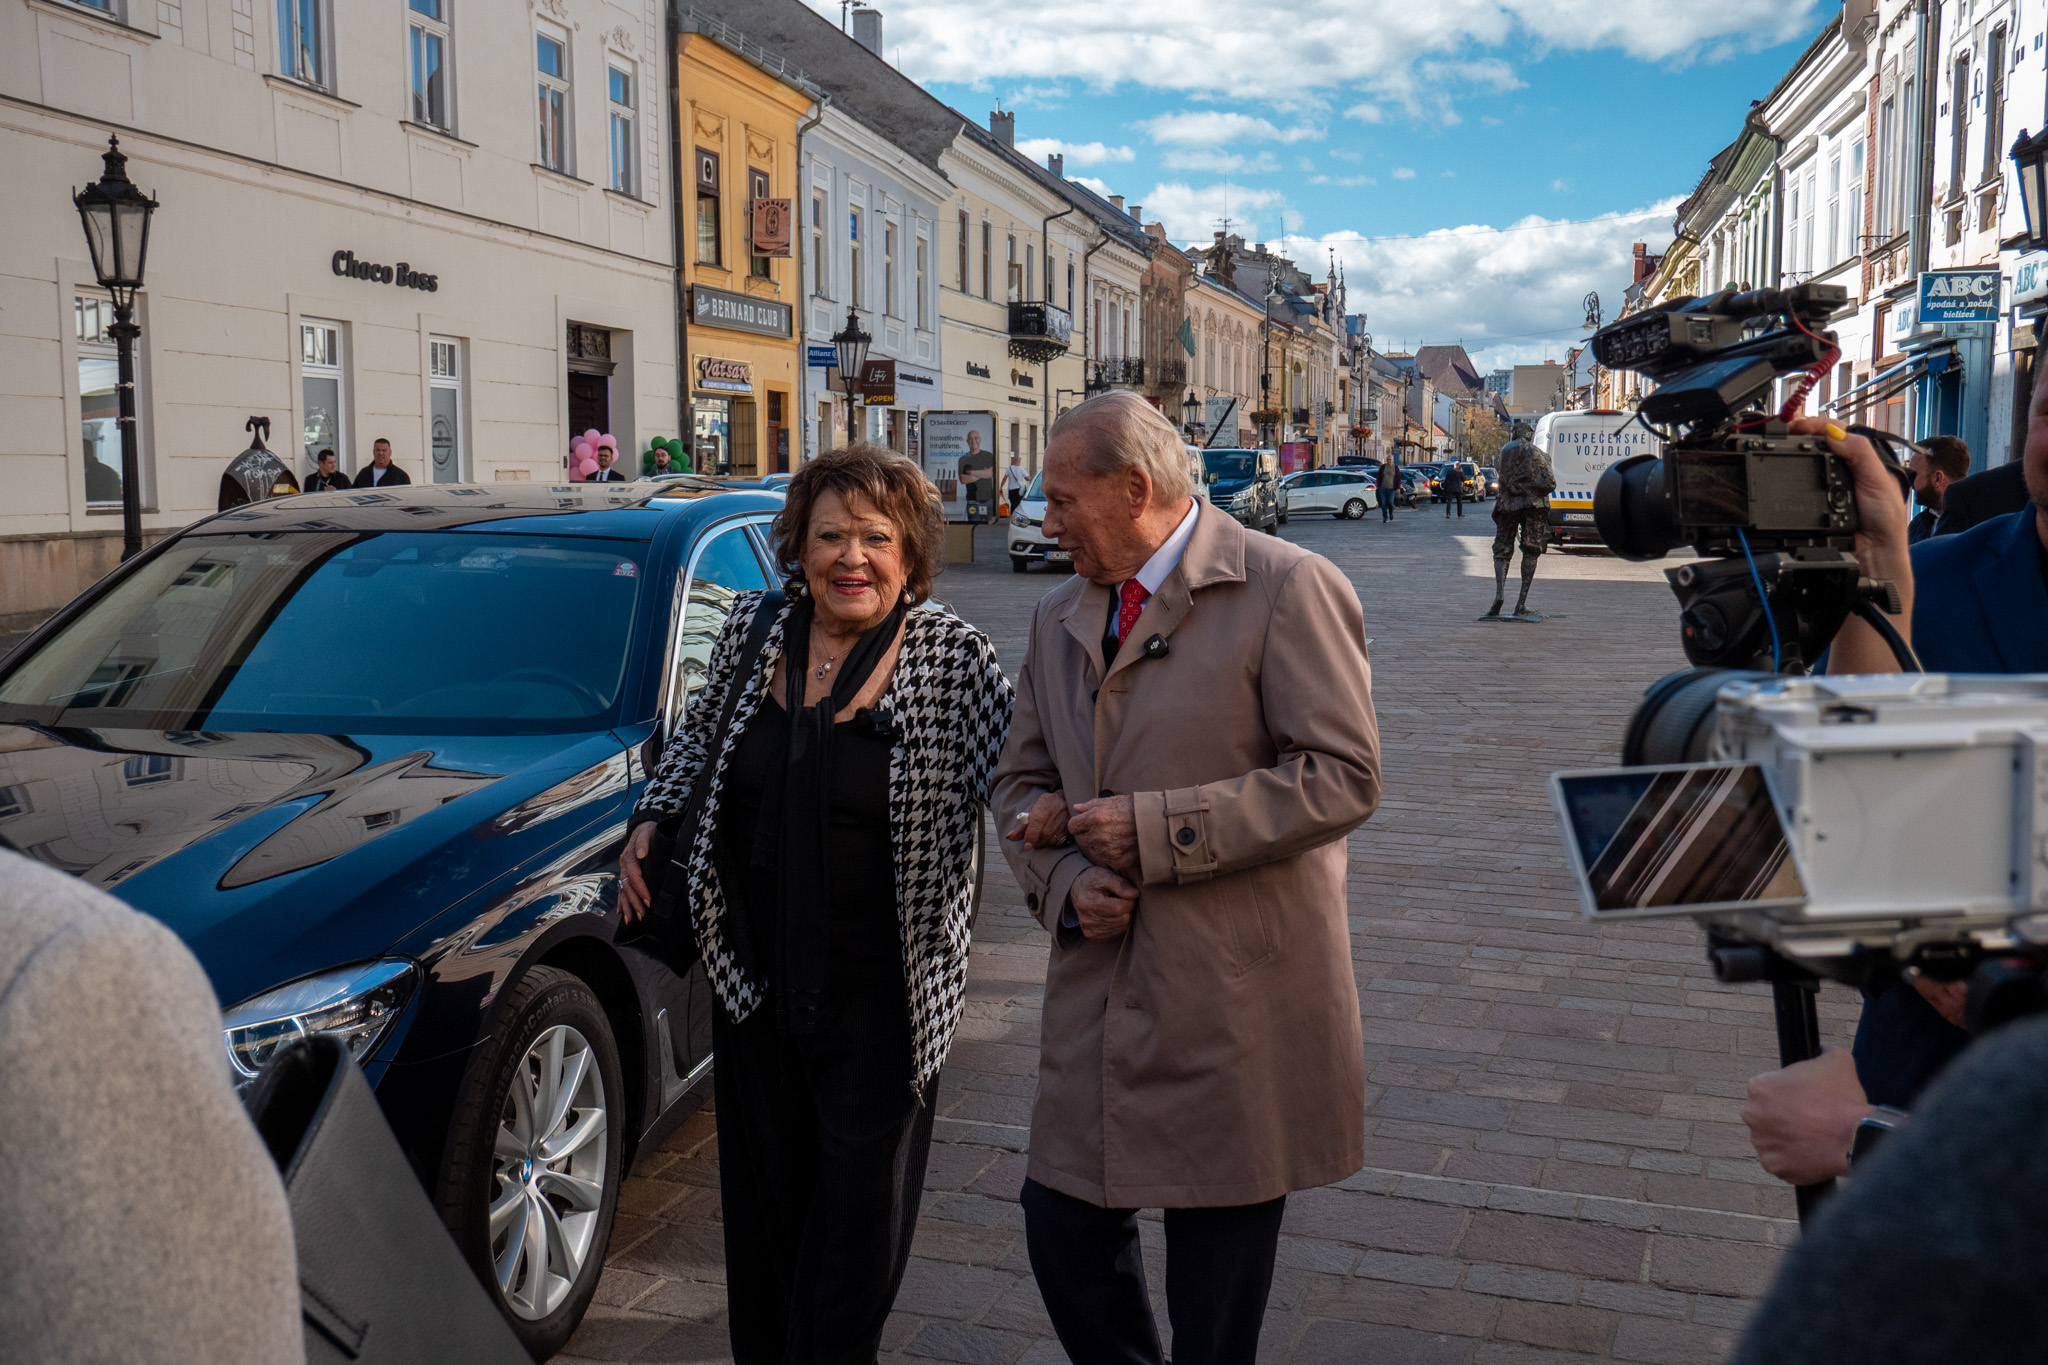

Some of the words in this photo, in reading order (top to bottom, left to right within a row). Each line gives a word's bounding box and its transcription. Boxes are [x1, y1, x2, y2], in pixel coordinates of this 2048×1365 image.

[757, 200, 788, 211] BERNARD
[332, 249, 394, 284] Choco
[396, 262, 438, 292] Boss
[2013, 260, 2039, 295] ABC
[1927, 275, 1993, 297] ABC
[1927, 300, 1956, 310] spodná
[1967, 299, 1993, 308] nočná
[711, 298, 754, 323] BERNARD
[757, 307, 778, 327] CLUB
[1896, 307, 1912, 332] ABC
[1943, 309, 1975, 319] bielizeň
[1559, 430, 1646, 444] DISPEČERSKÉ
[1576, 445, 1631, 456] VOZIDLO
[572, 989, 578, 1000] 3
